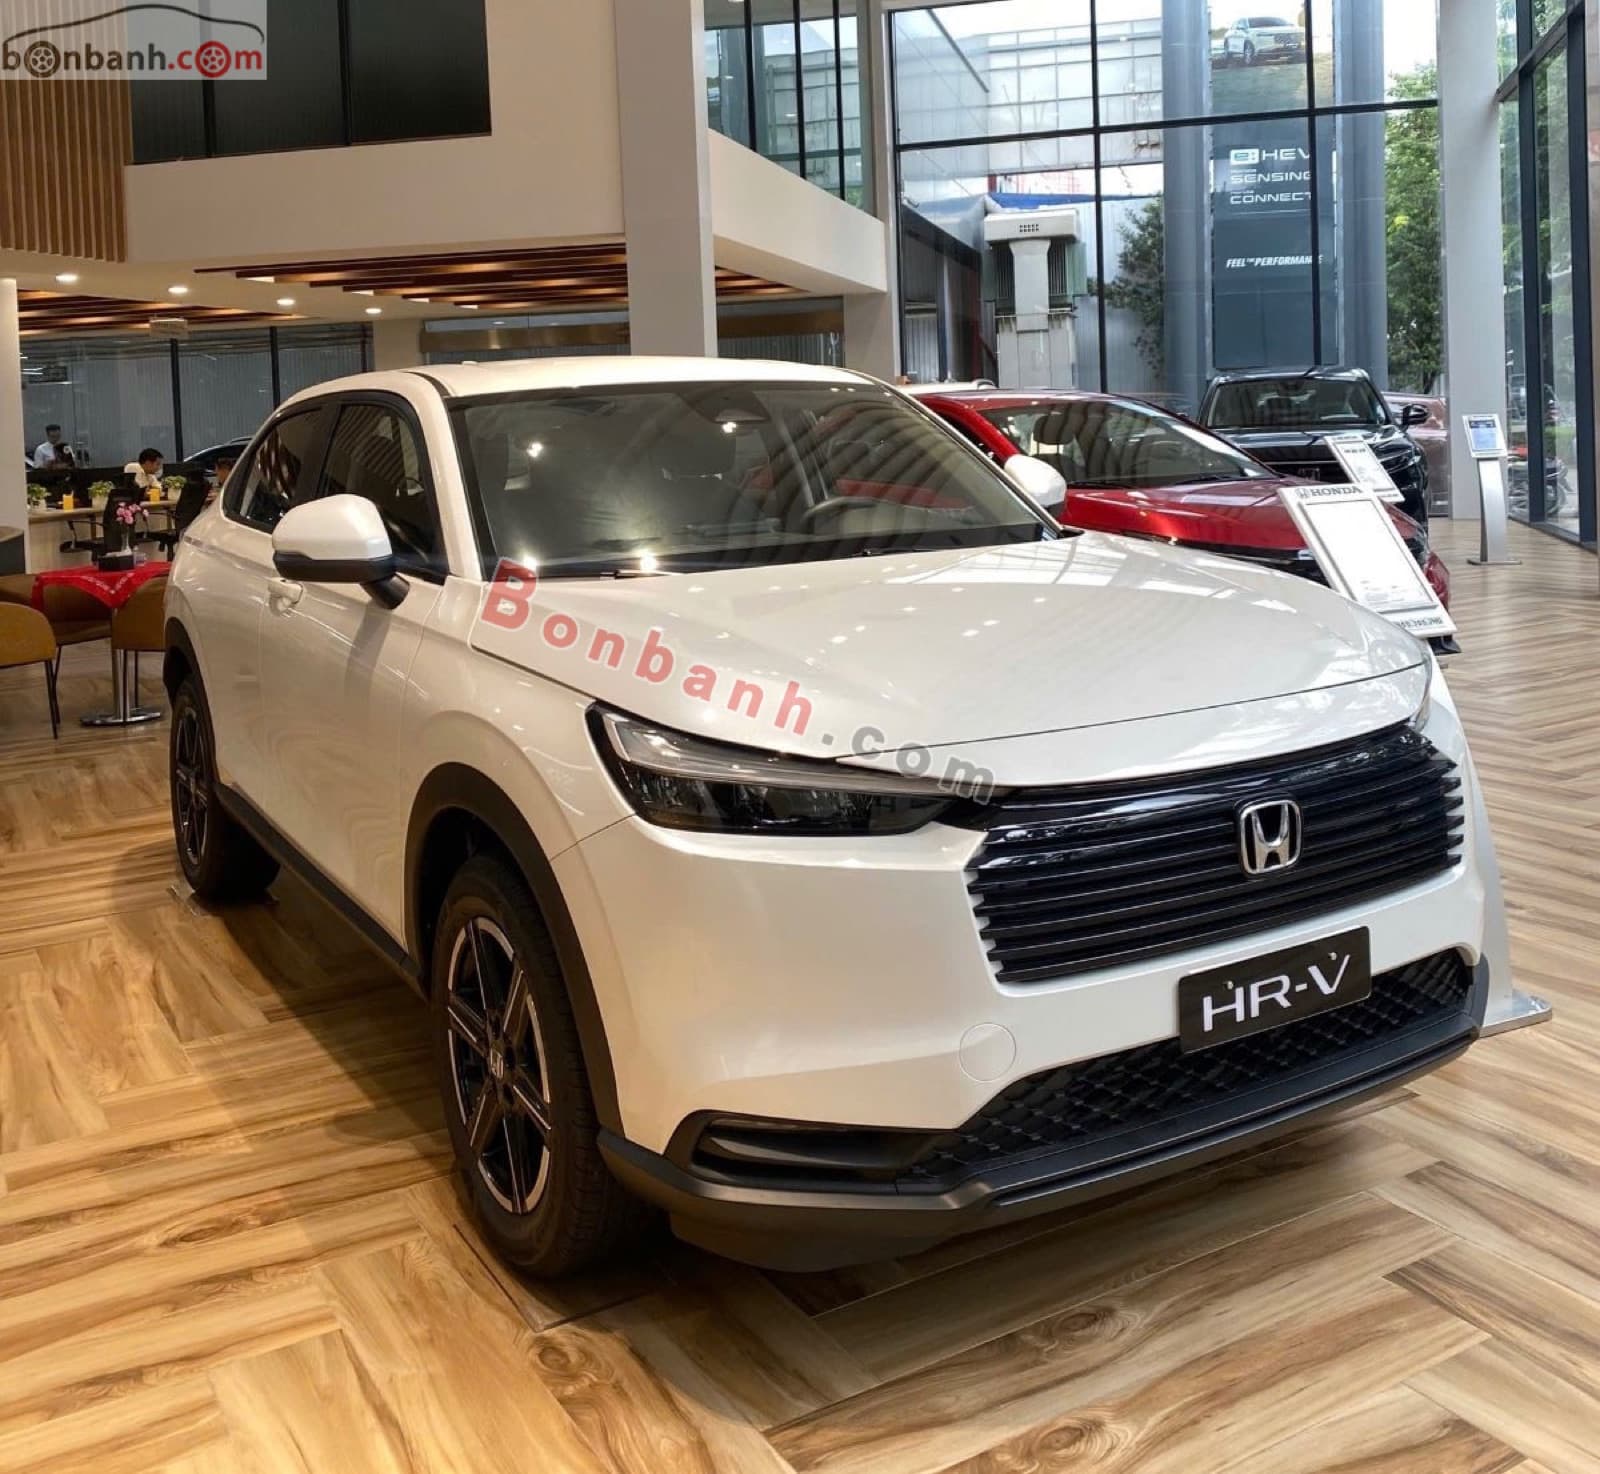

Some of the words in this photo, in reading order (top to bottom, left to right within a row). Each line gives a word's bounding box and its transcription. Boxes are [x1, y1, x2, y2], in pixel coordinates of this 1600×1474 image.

[1226, 258, 1246, 268] FEEL
[1310, 486, 1363, 496] HONDA
[1203, 954, 1350, 1032] HR-V
